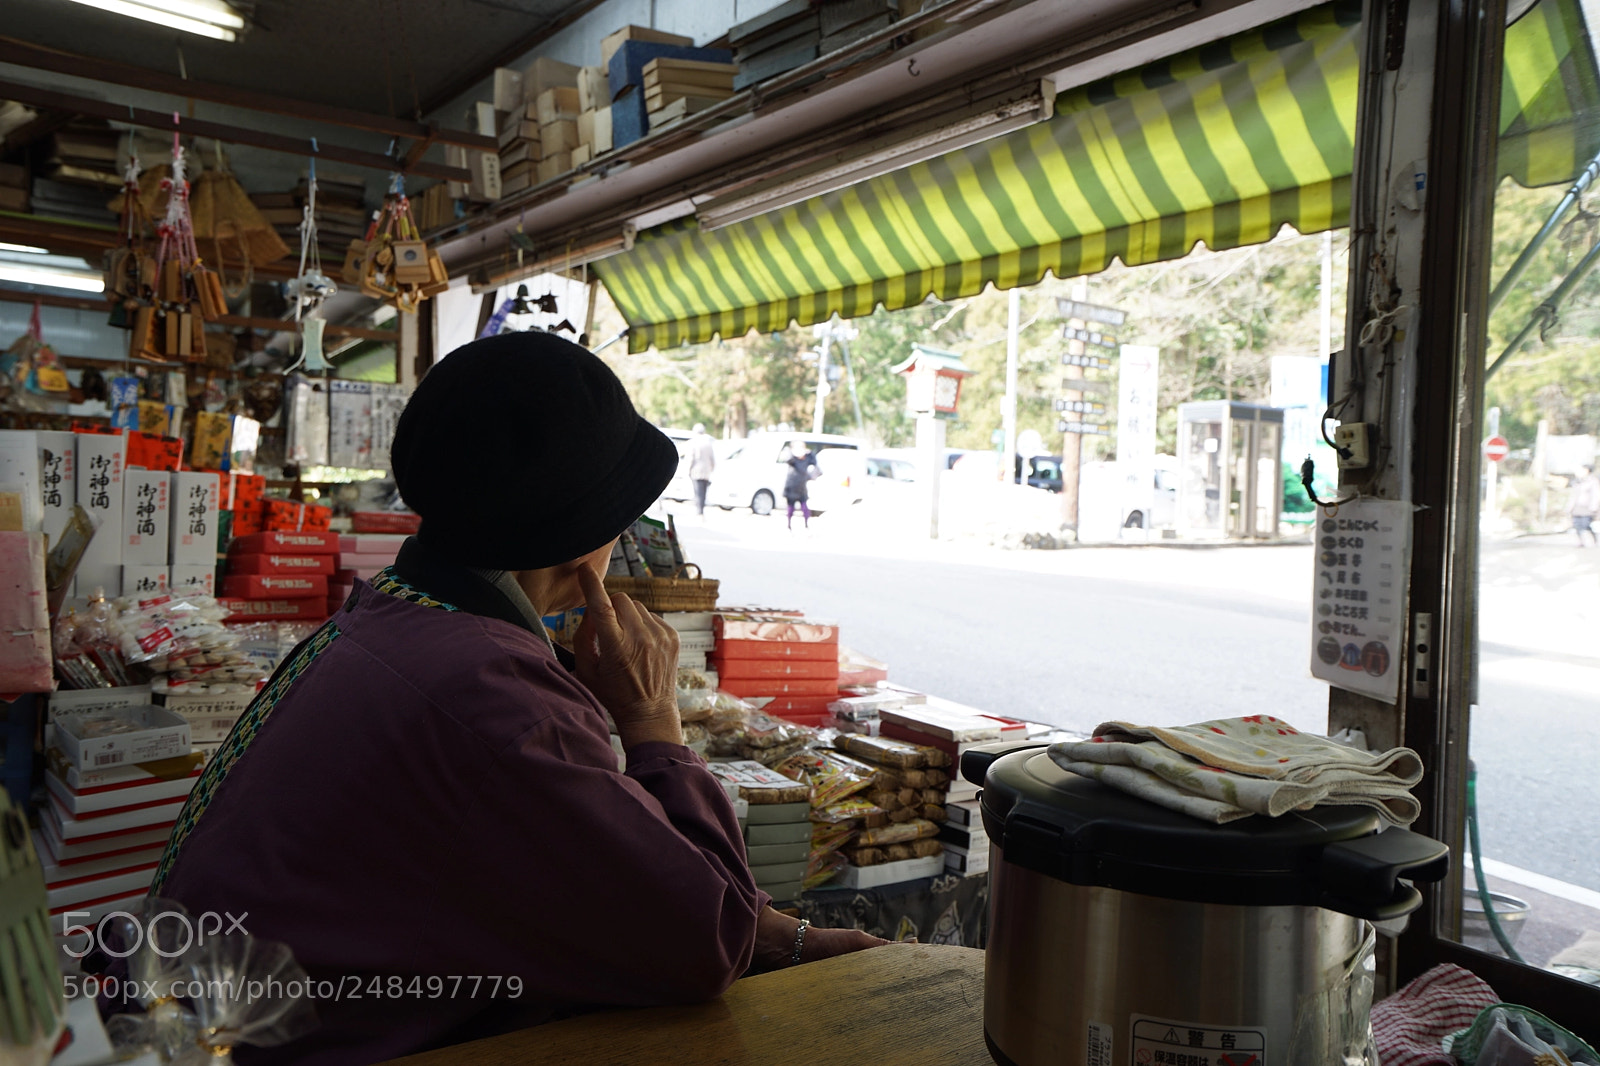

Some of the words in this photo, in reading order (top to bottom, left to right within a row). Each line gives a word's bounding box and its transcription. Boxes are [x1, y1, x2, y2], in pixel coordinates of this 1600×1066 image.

[89, 454, 111, 509] 御神酒
[136, 483, 158, 536] 御神酒
[188, 484, 208, 536] 御神酒
